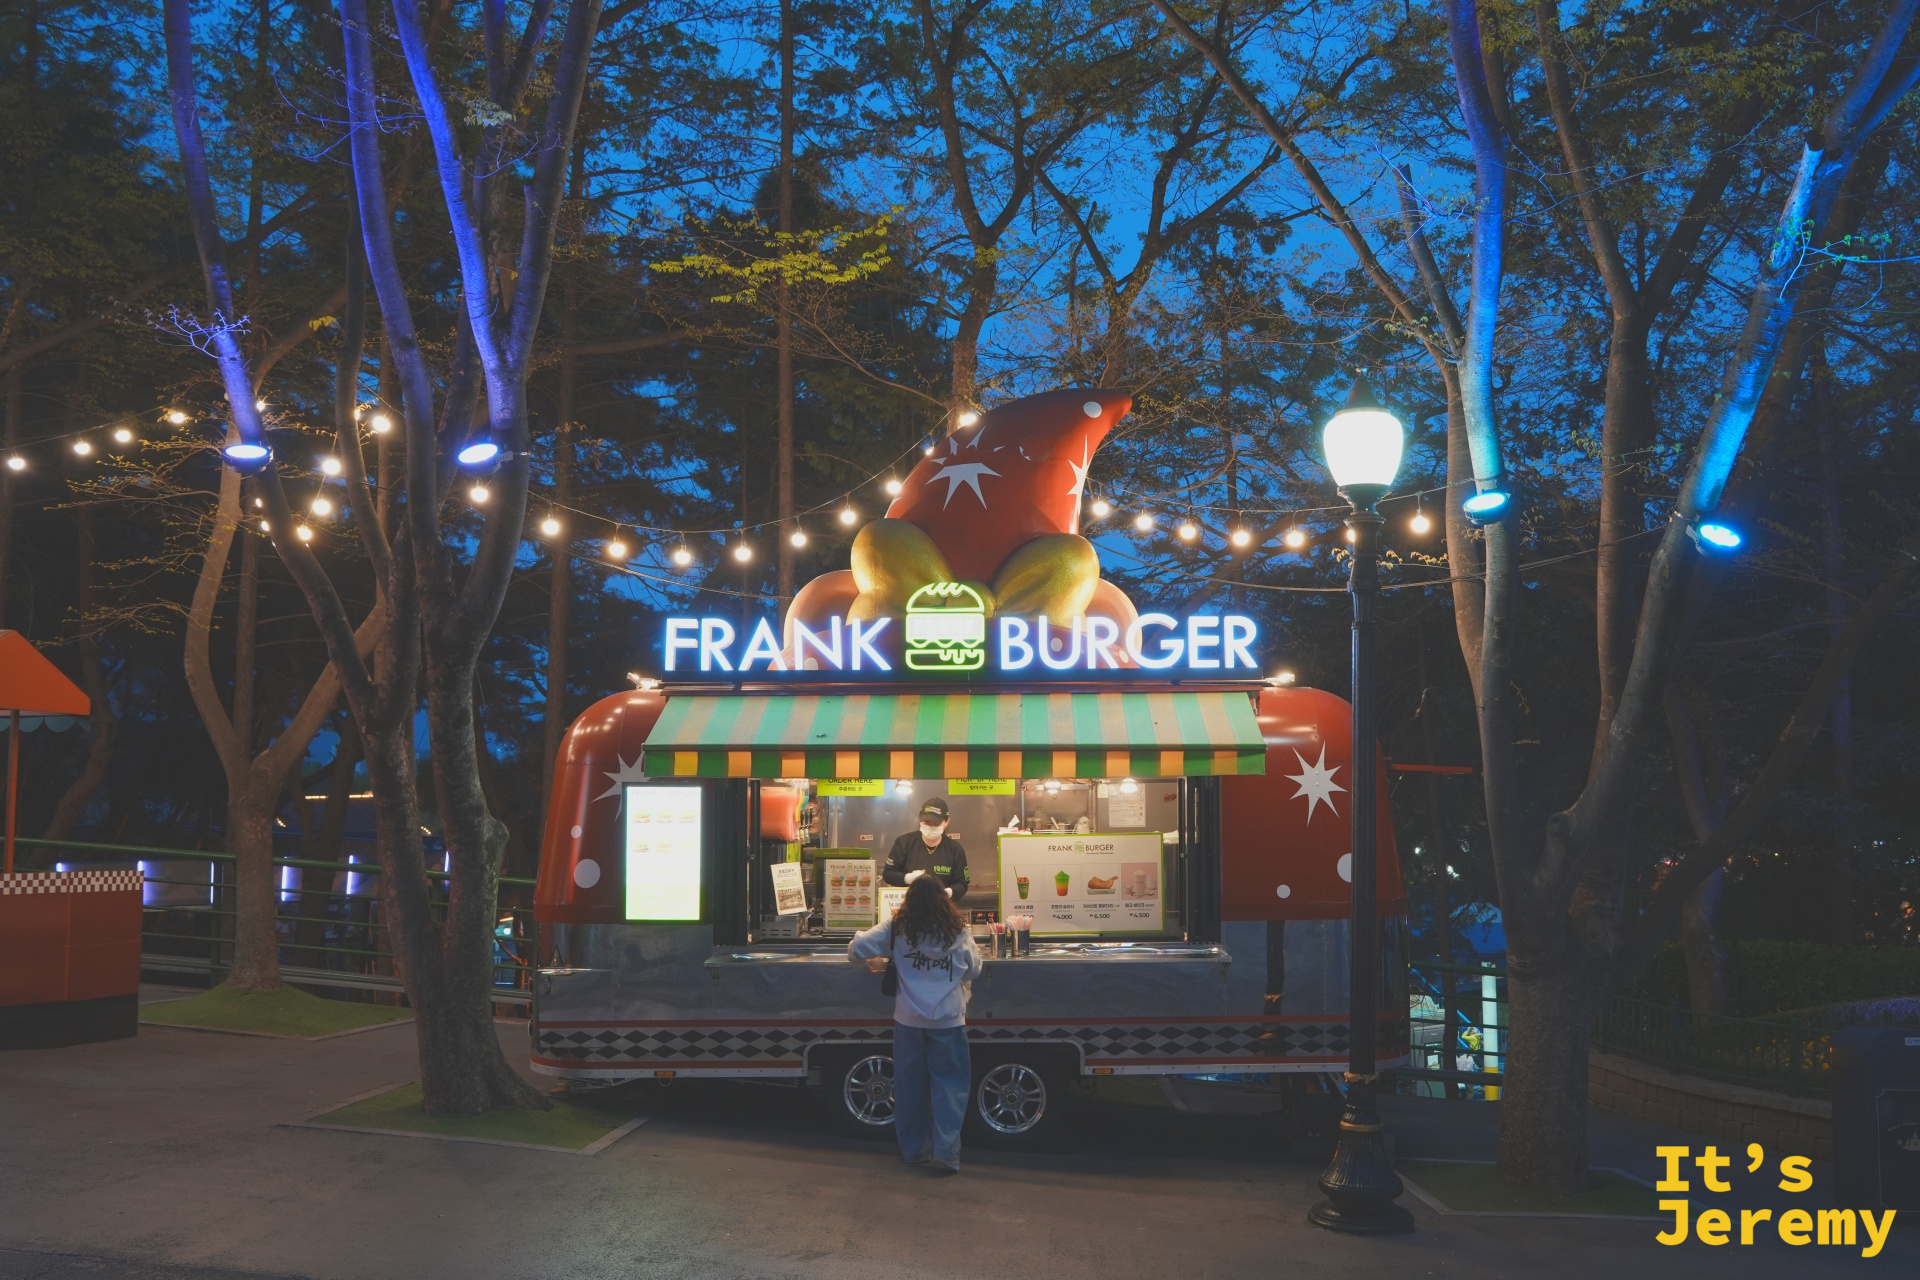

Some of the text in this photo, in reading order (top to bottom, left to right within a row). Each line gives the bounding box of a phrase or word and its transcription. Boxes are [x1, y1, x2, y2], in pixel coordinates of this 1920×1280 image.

[663, 616, 893, 671] FRANK
[999, 612, 1260, 671] BURGER
[1048, 843, 1114, 852] FRANK BURGER
[933, 865, 952, 874] FRANK
